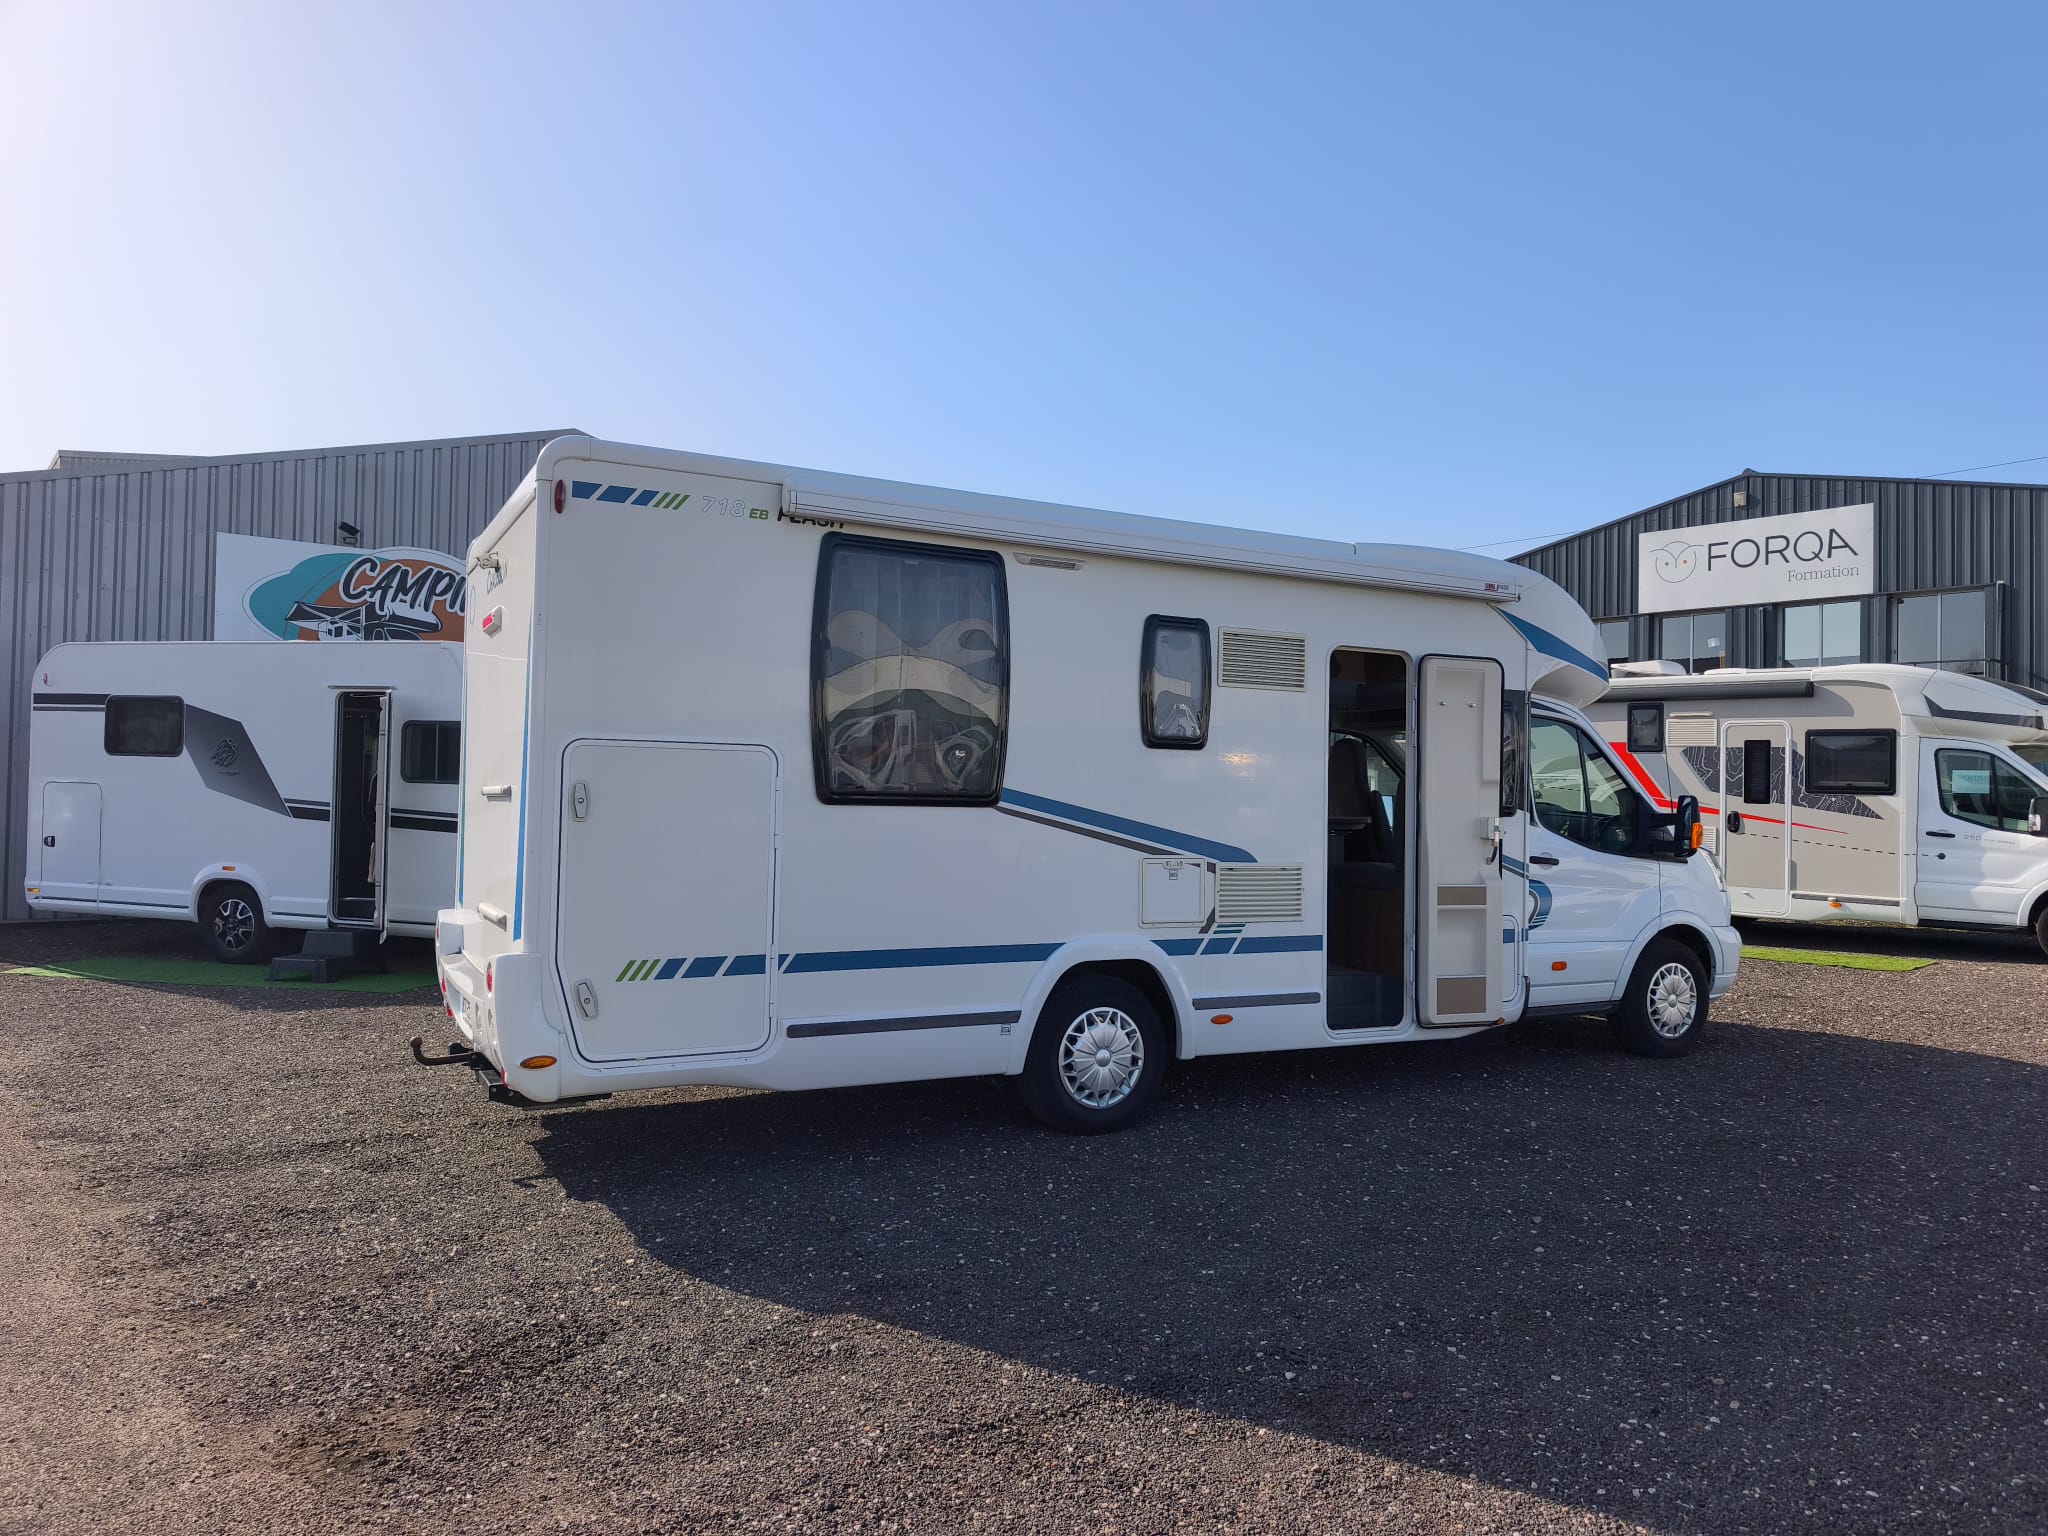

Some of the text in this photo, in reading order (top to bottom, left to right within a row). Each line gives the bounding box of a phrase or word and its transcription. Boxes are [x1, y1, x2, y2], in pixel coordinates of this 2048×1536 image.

[701, 495, 746, 518] 718
[749, 508, 769, 520] EB
[1707, 528, 1859, 572] FORQA
[1788, 565, 1860, 582] Formation
